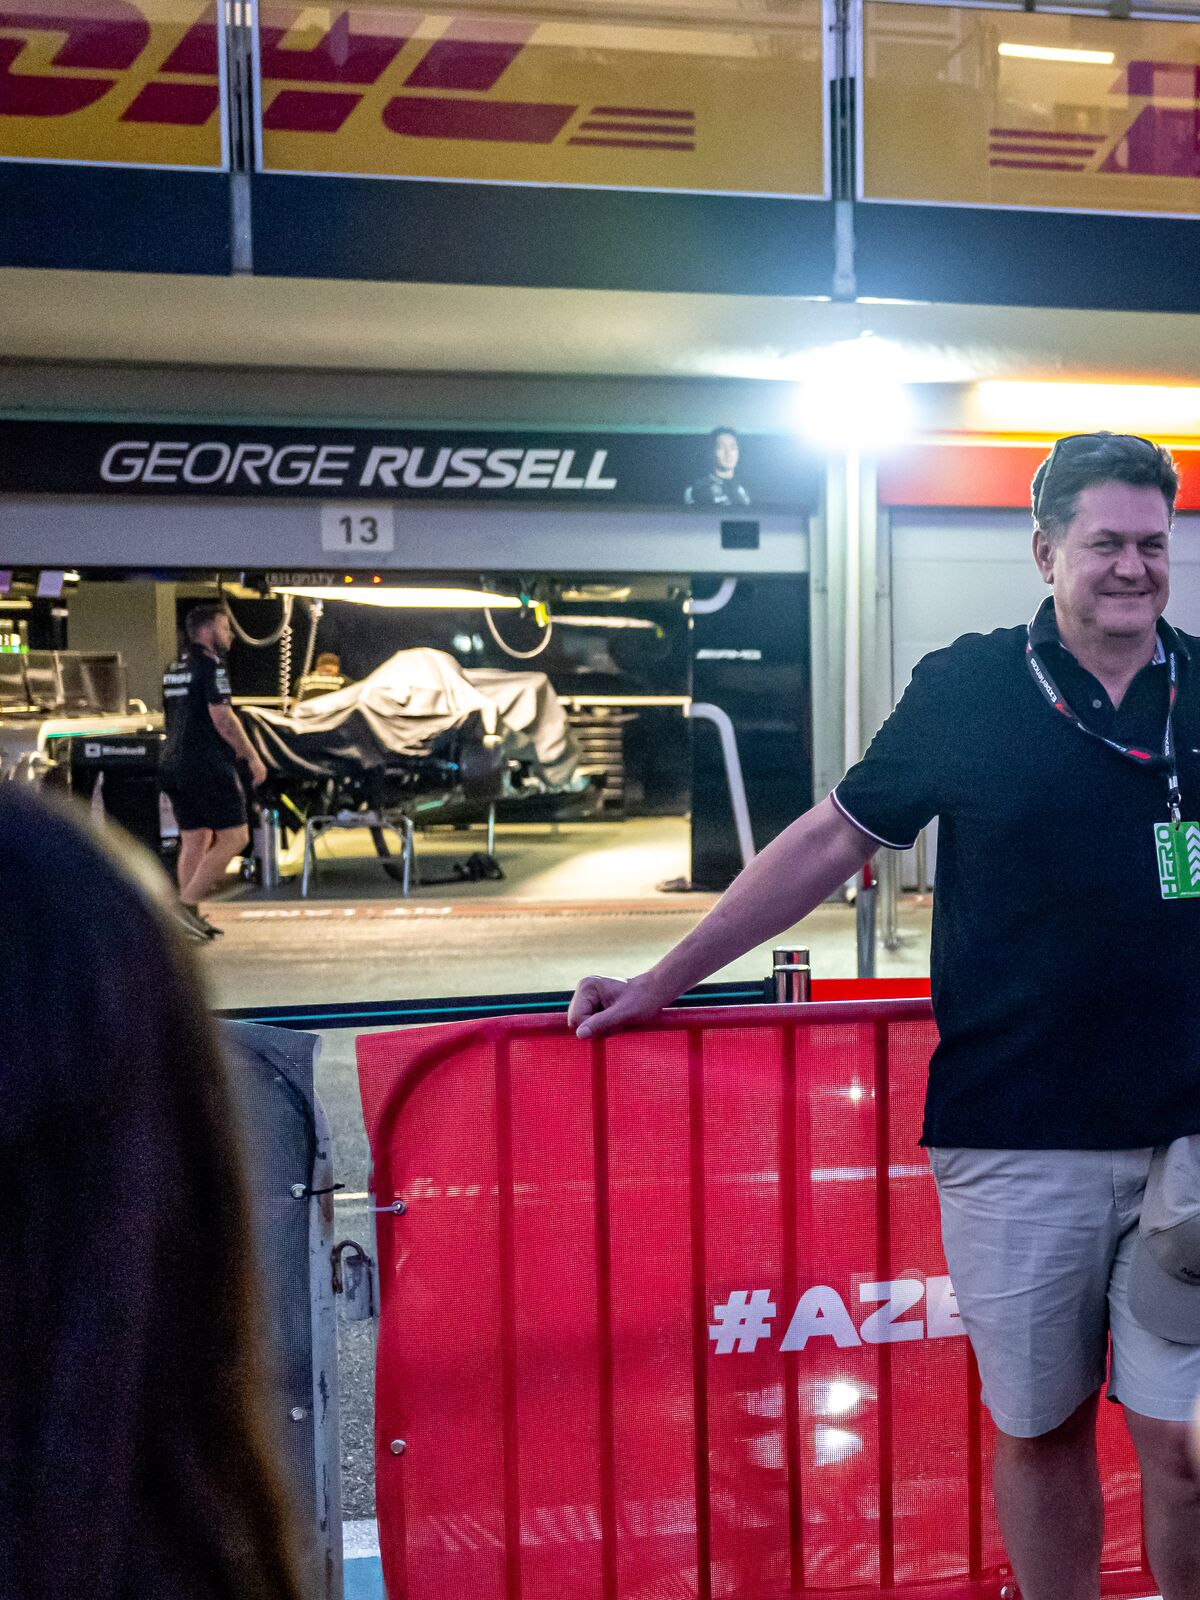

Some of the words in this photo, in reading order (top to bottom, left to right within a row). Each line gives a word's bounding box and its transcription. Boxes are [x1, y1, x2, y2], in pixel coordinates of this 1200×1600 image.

[100, 440, 355, 487] GEORGE
[359, 446, 618, 490] RUSSELL
[337, 514, 379, 545] 13
[1156, 825, 1180, 898] HERO
